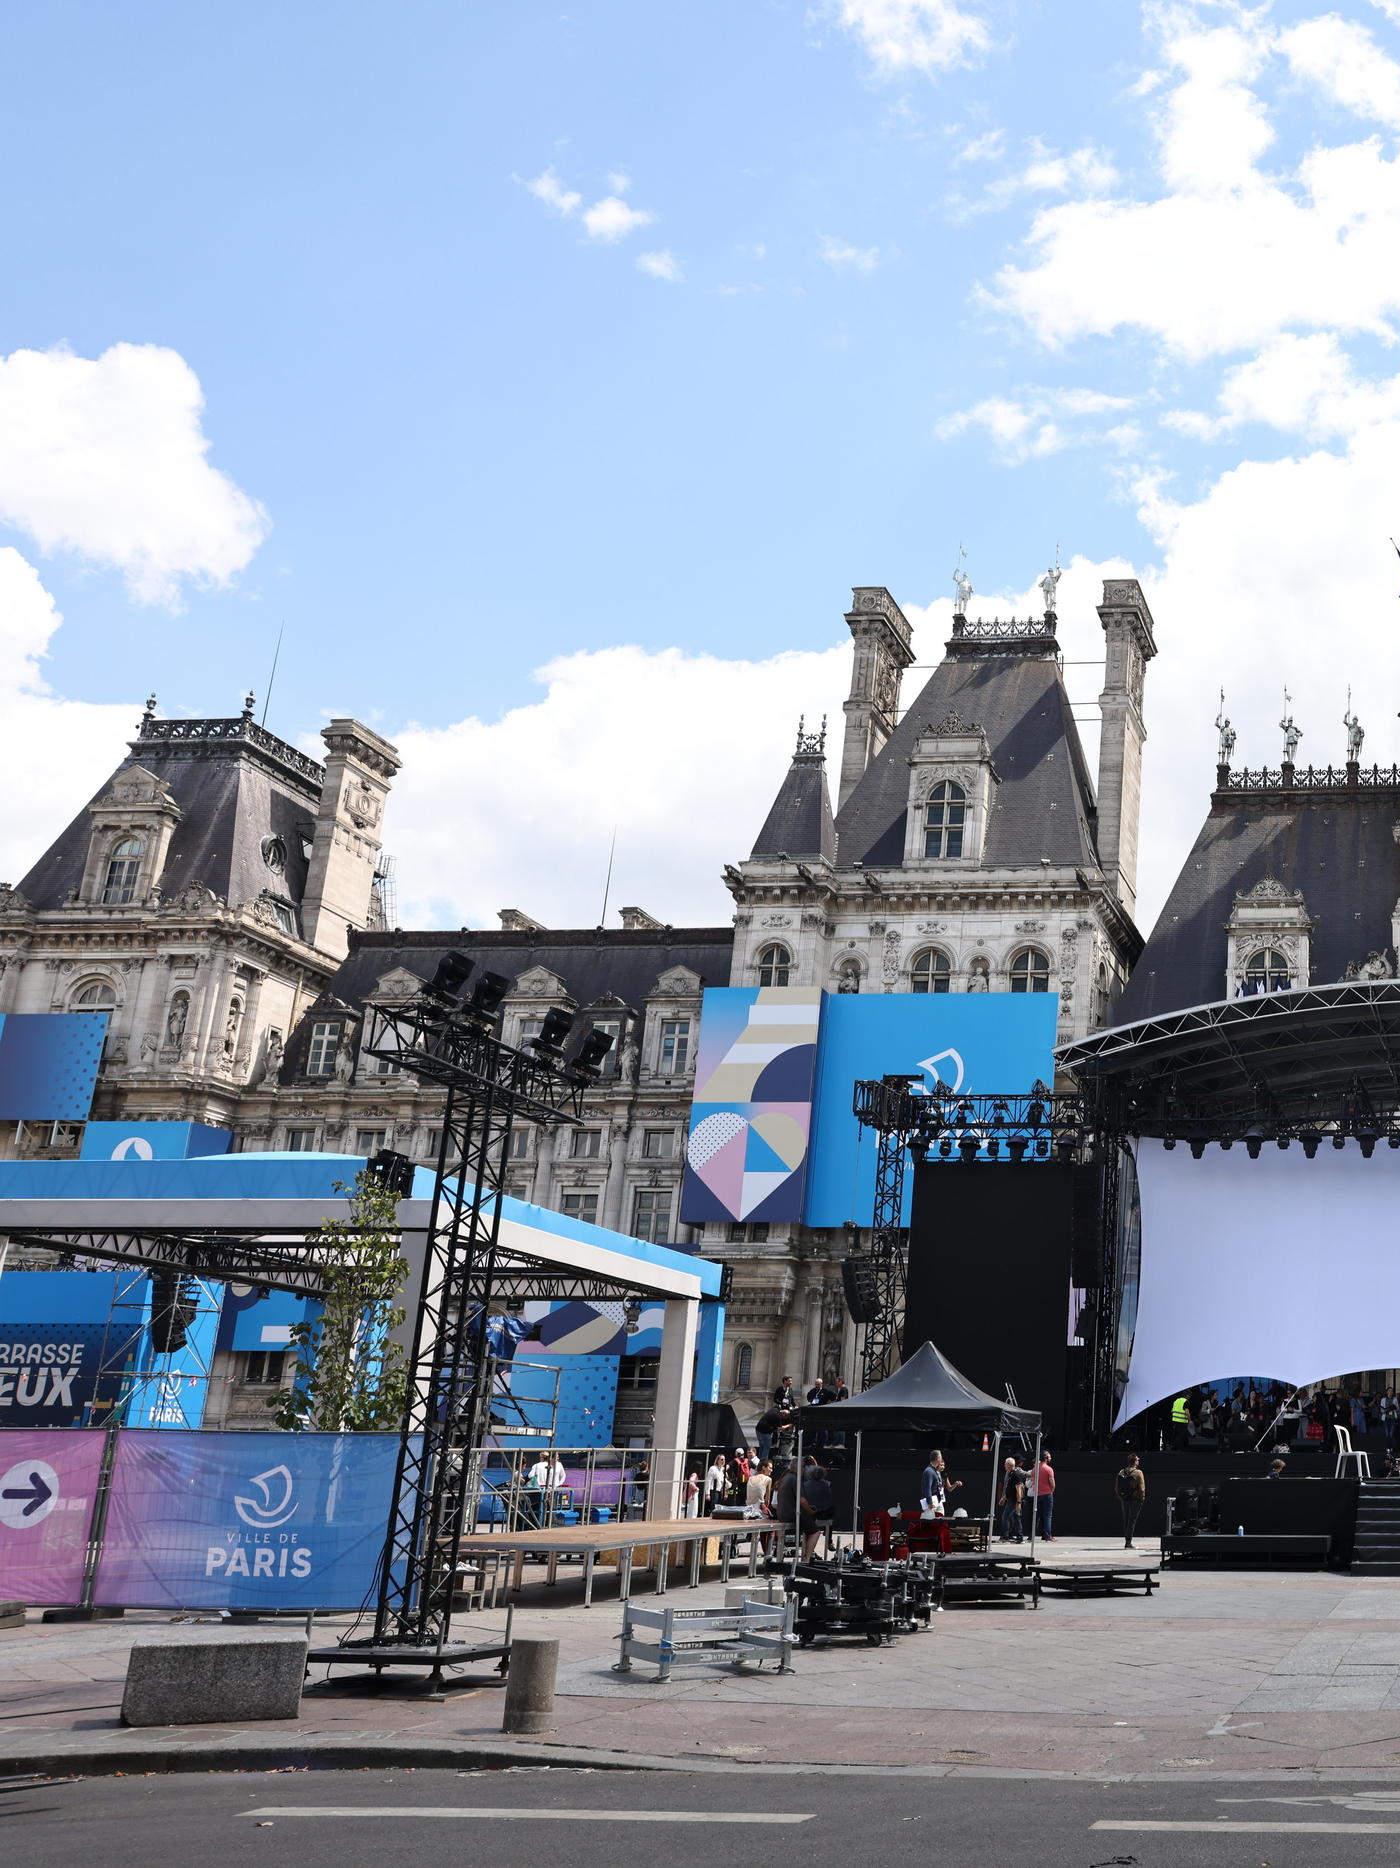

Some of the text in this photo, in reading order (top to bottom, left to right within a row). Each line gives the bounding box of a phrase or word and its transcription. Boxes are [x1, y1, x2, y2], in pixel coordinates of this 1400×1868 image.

[226, 1533, 299, 1544] VILLE DE
[205, 1546, 313, 1578] PARIS
